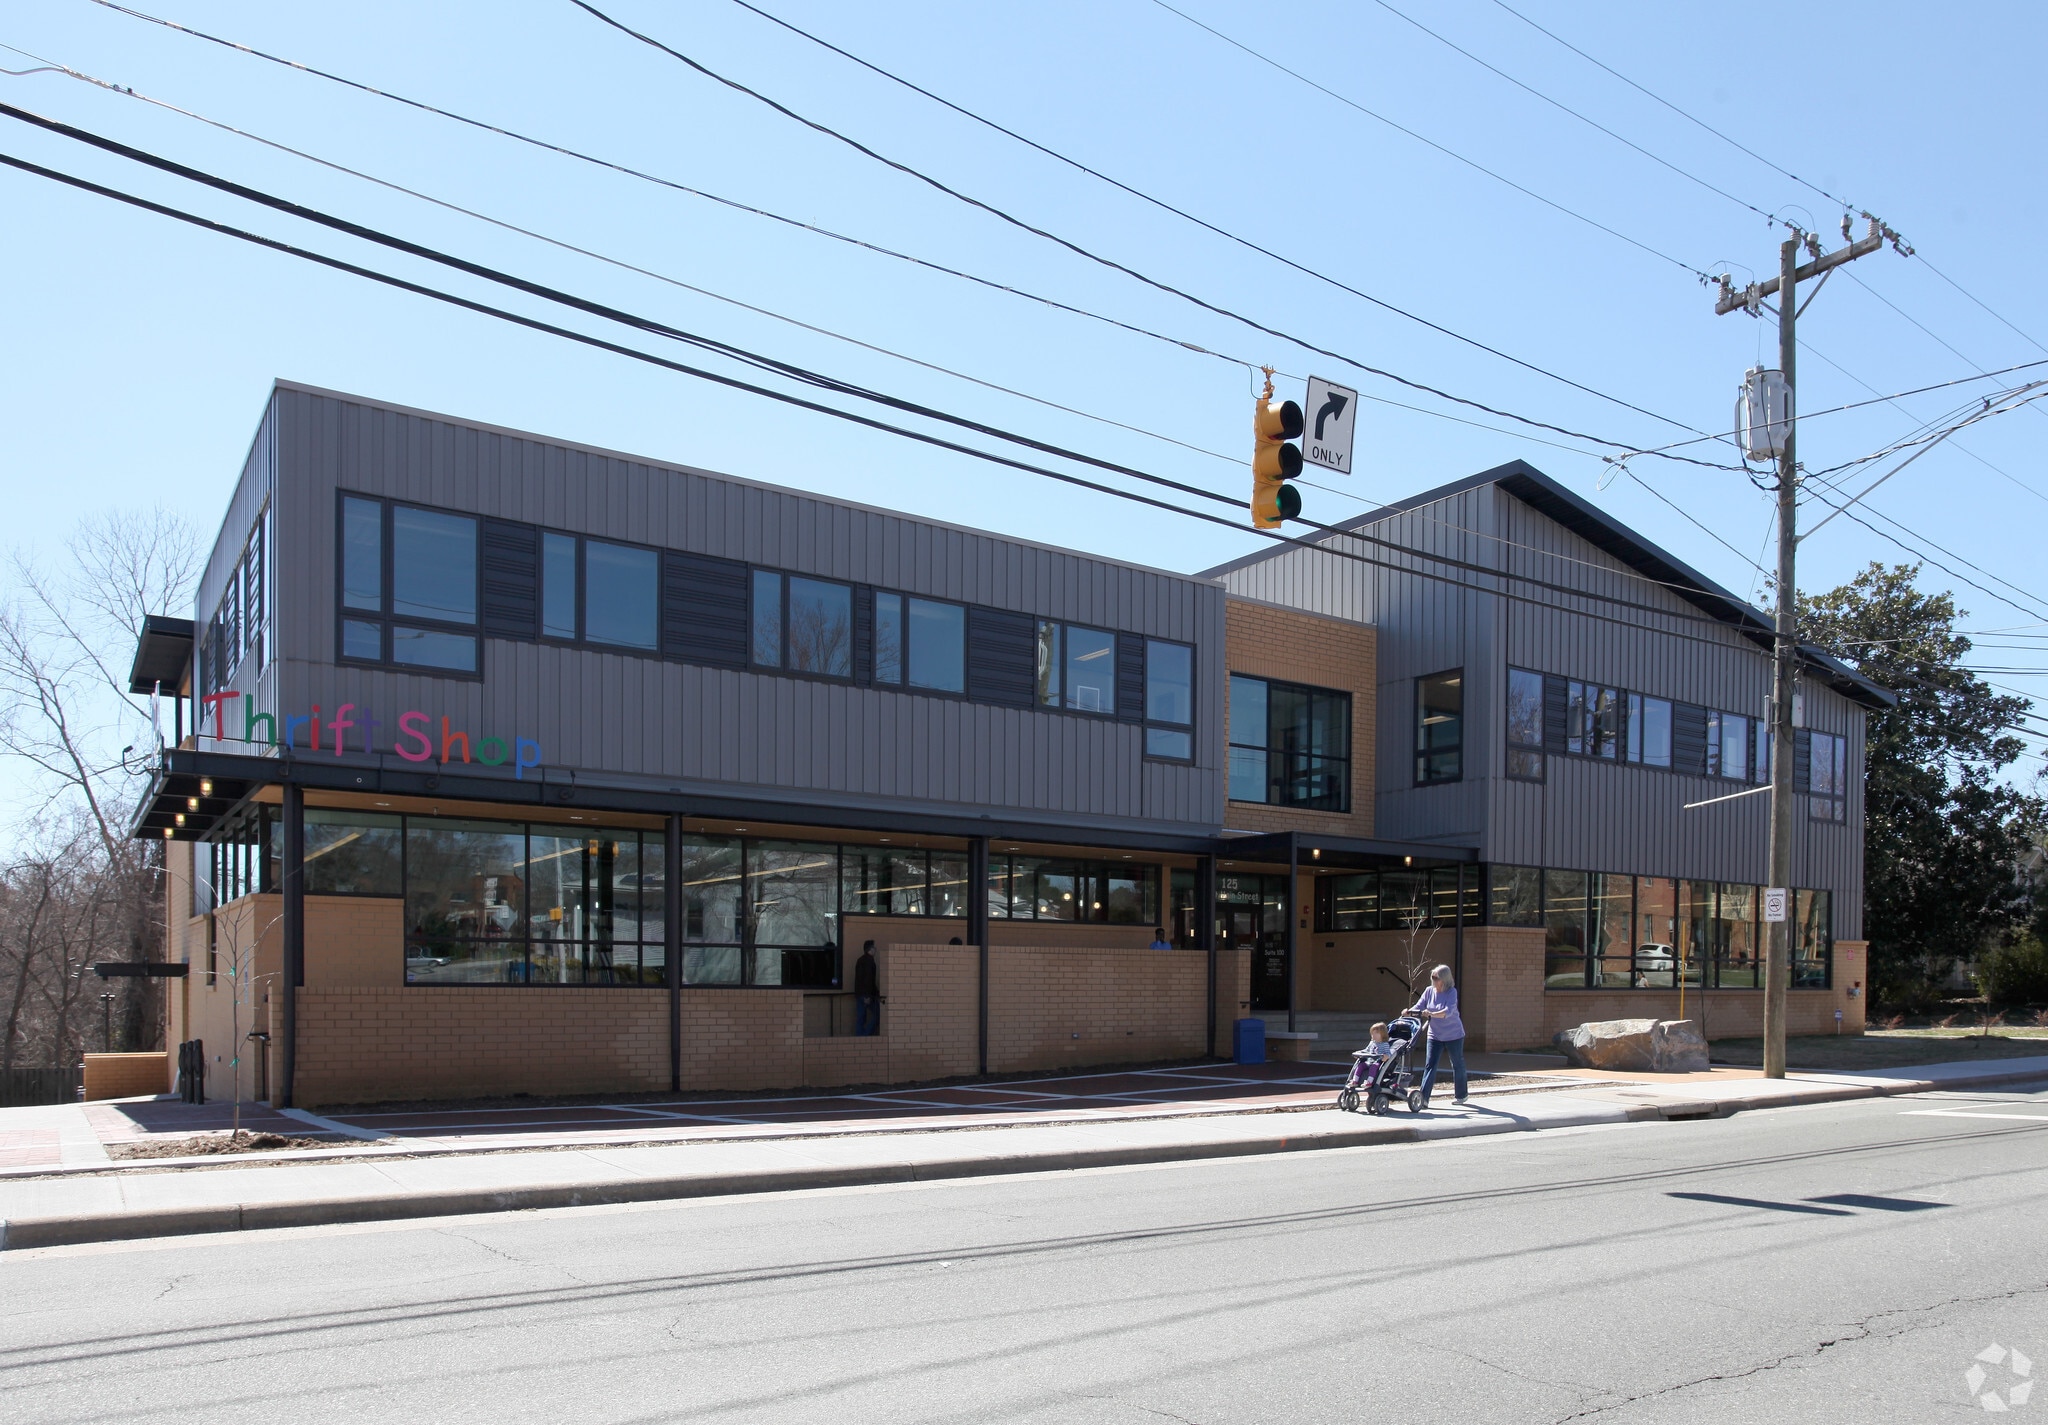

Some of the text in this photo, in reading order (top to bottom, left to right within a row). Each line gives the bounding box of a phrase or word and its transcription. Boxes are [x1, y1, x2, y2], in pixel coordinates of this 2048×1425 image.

[1312, 446, 1343, 466] ONLY
[202, 690, 542, 779] Thrift Shop
[1222, 878, 1238, 890] 125
[1237, 891, 1259, 901] Street
